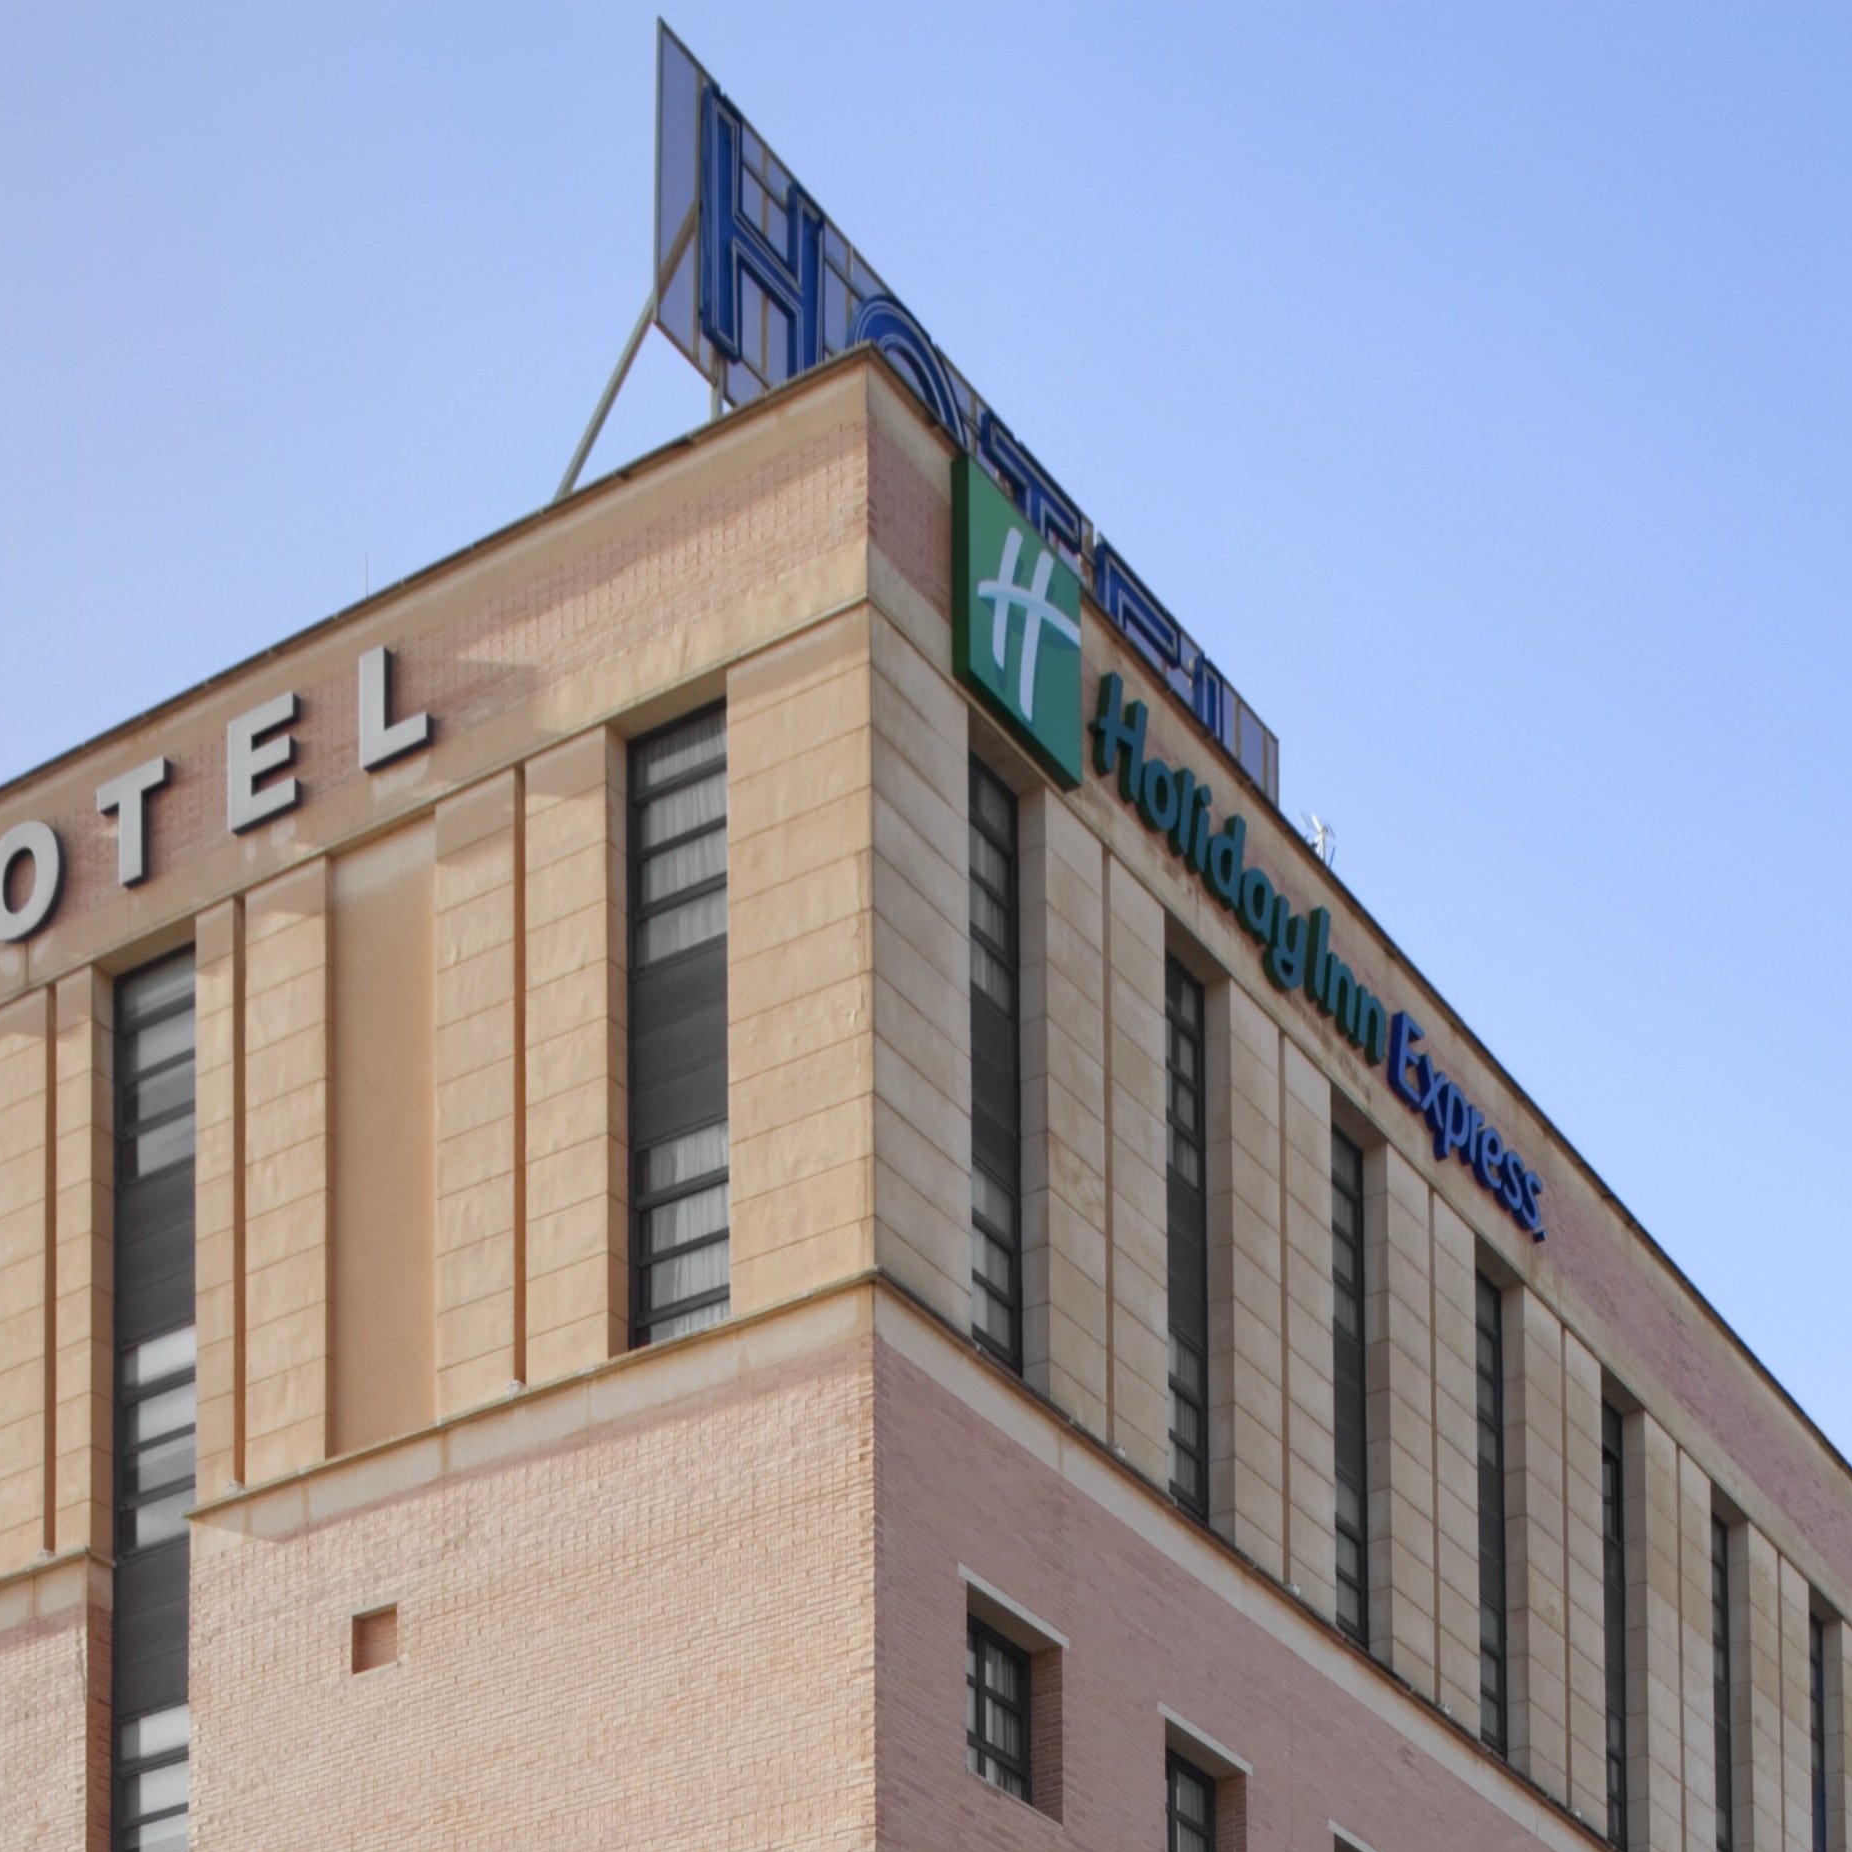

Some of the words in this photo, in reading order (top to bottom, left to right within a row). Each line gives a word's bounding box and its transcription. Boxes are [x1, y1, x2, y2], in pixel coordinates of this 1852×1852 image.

[1089, 671, 1309, 990] Holiday
[1305, 906, 1387, 1067] Inn
[1389, 1008, 1548, 1243] Express
